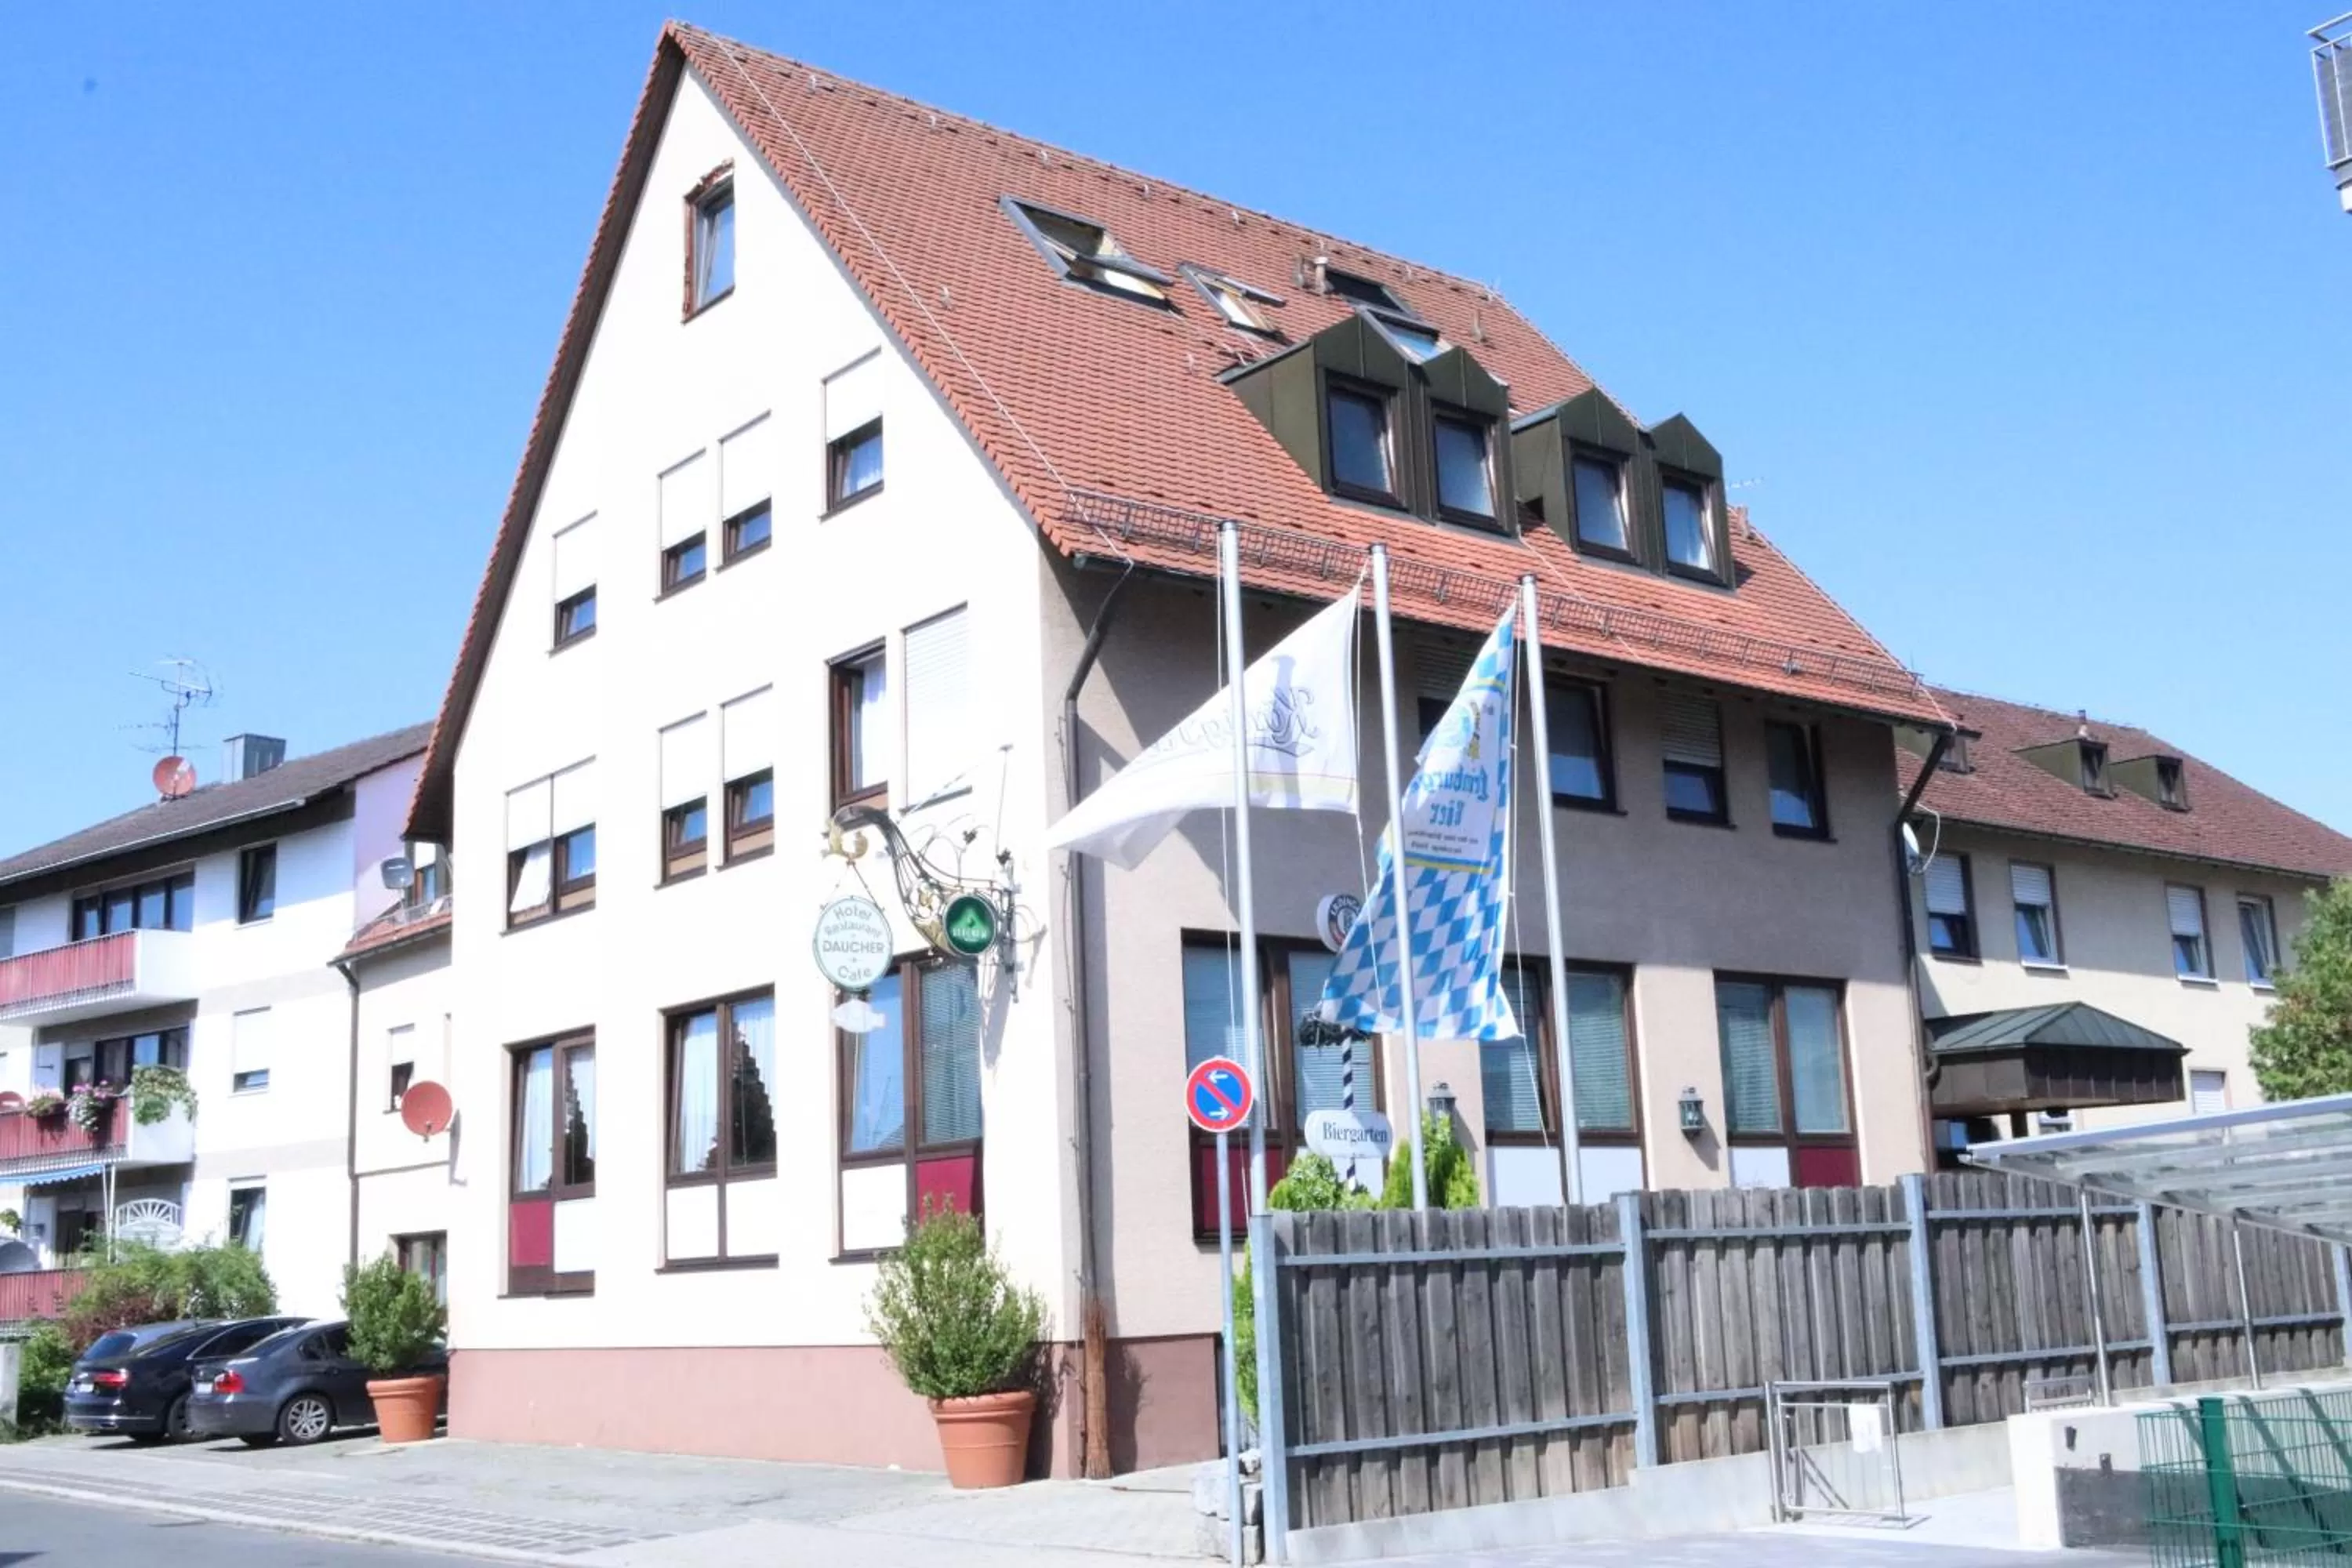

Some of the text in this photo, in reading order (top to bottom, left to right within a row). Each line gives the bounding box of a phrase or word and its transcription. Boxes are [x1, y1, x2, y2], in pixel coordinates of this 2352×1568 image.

[833, 904, 873, 921] Hotel
[1330, 896, 1361, 917] ERDINGE
[824, 920, 882, 938] Restaurant
[822, 940, 885, 954] DAUCHER
[1322, 1121, 1388, 1145] Biergarten
